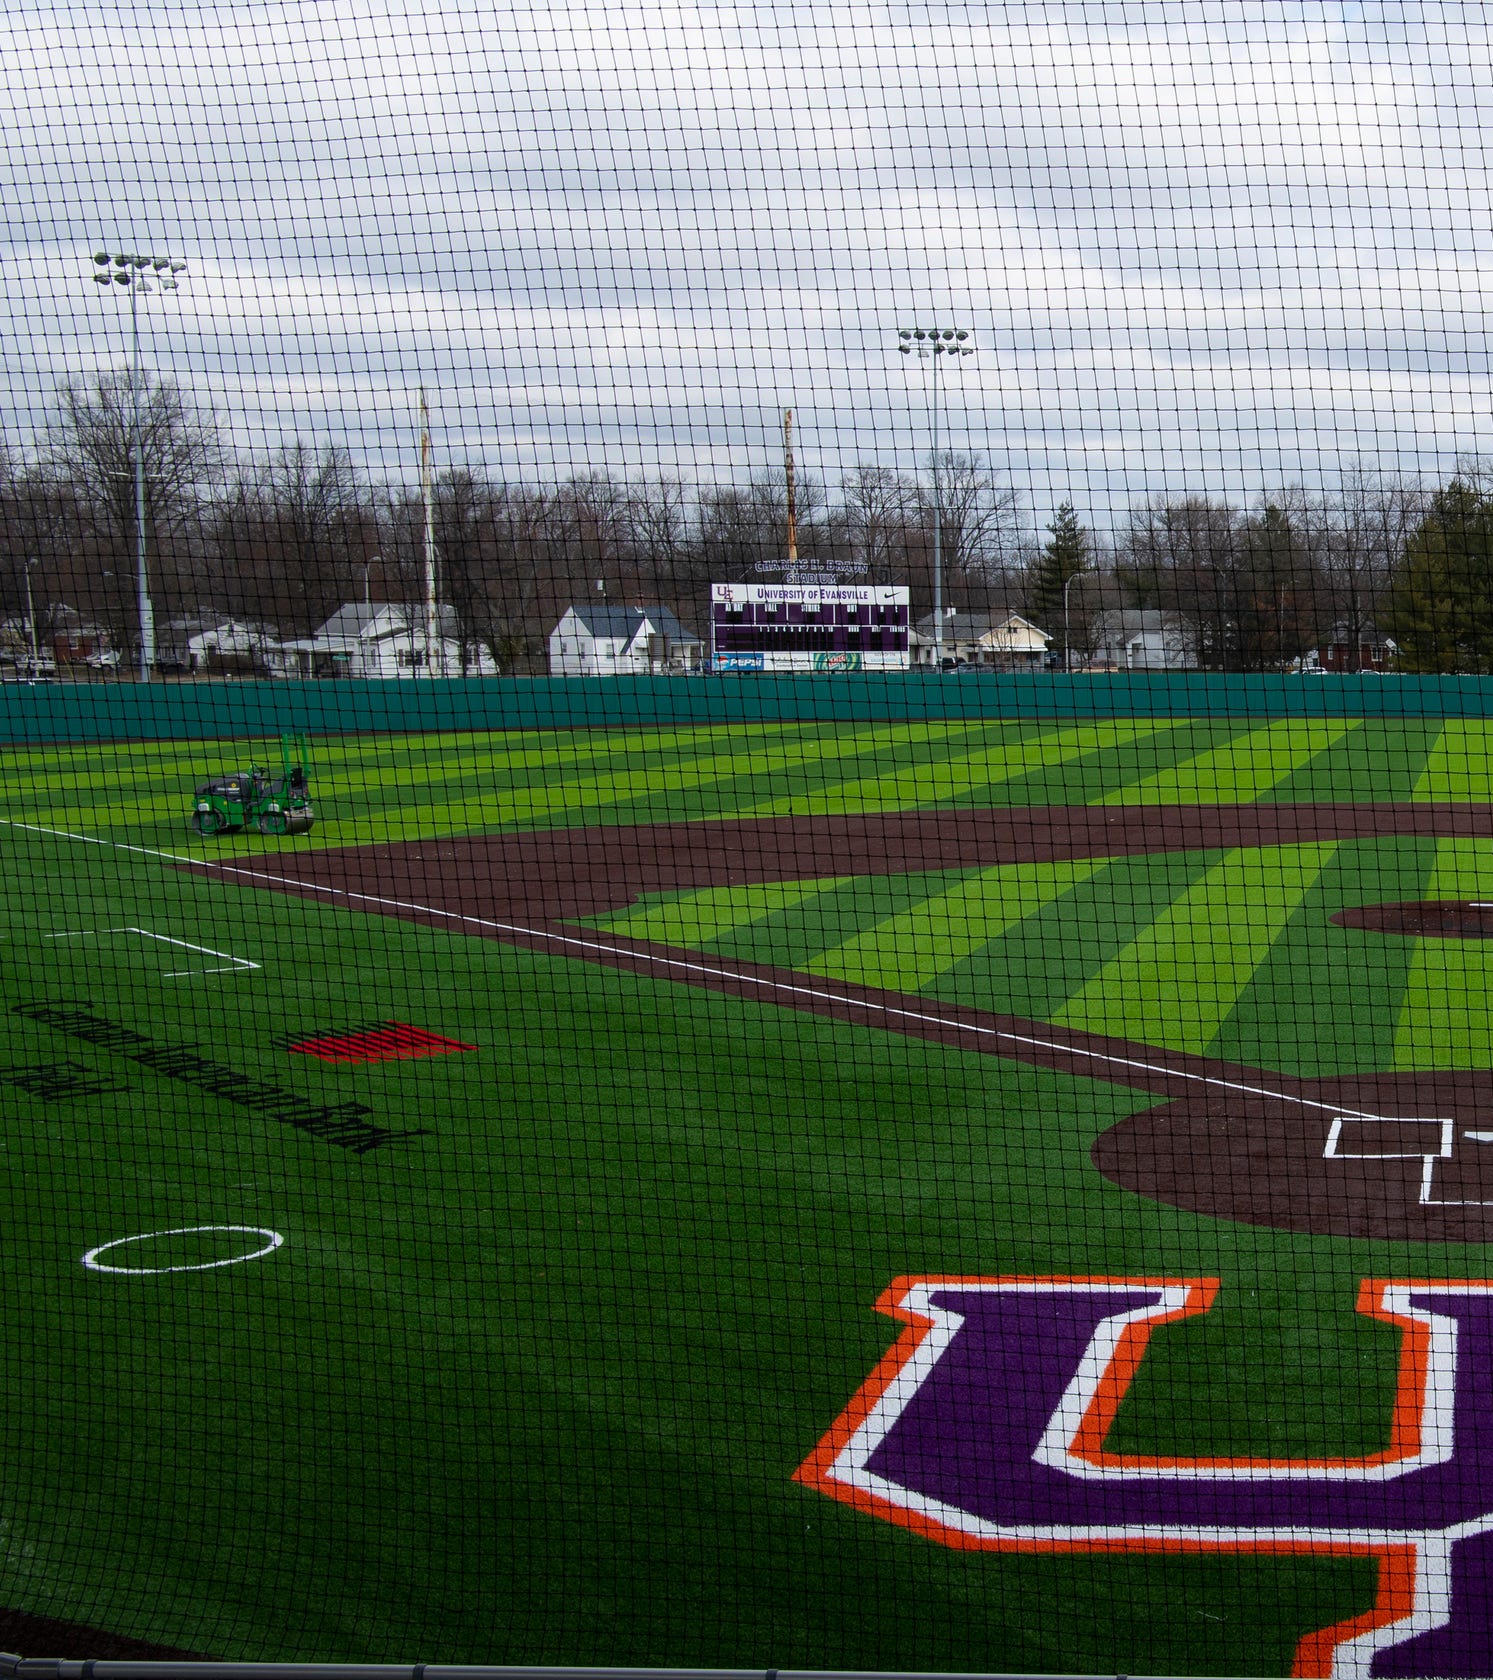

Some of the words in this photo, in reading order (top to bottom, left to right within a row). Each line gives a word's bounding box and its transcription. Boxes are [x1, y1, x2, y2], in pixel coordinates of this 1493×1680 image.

[755, 559, 808, 572] CHARLES
[810, 560, 824, 570] H.
[827, 560, 868, 574] BRAUN
[786, 573, 838, 584] STADIUM
[757, 588, 806, 600] UNIVERSITY
[820, 588, 868, 600] EVANSVILLE
